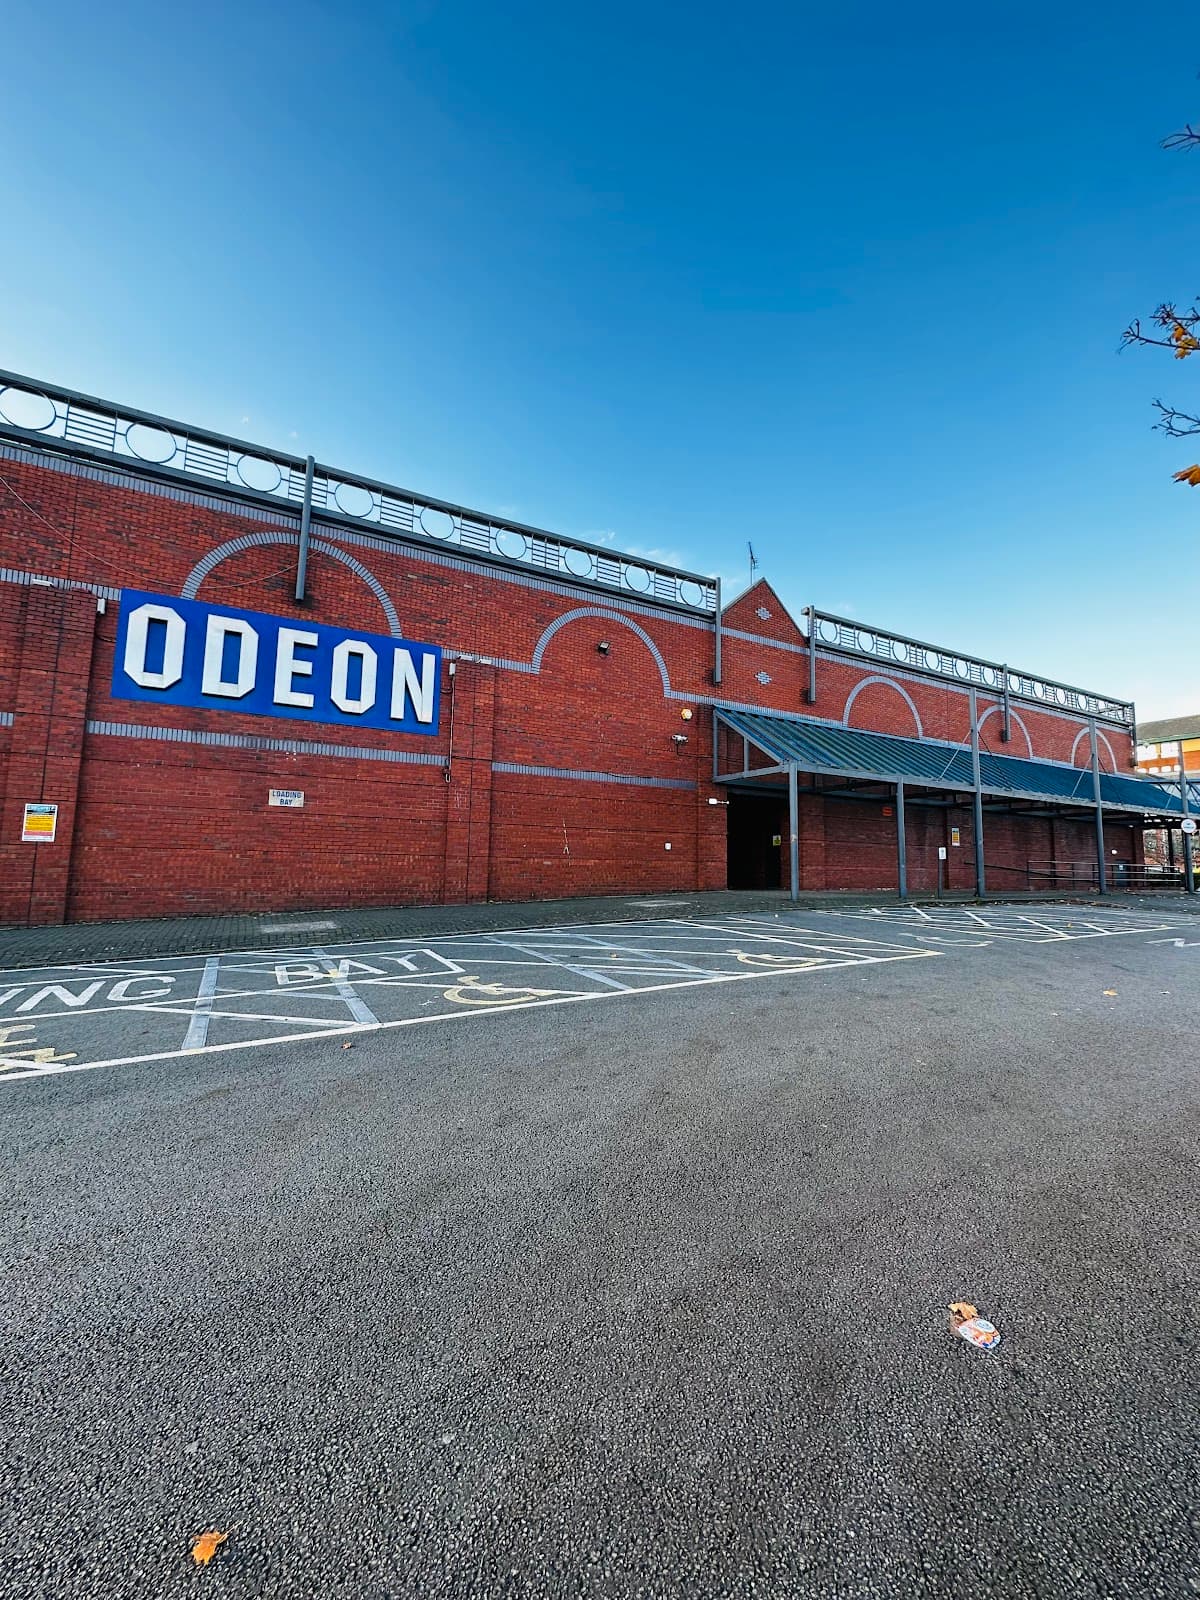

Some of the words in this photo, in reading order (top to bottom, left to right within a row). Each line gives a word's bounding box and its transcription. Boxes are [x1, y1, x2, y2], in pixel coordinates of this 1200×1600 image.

[123, 603, 436, 723] ODEON
[272, 791, 302, 799] LOADING
[275, 954, 420, 986] BAY
